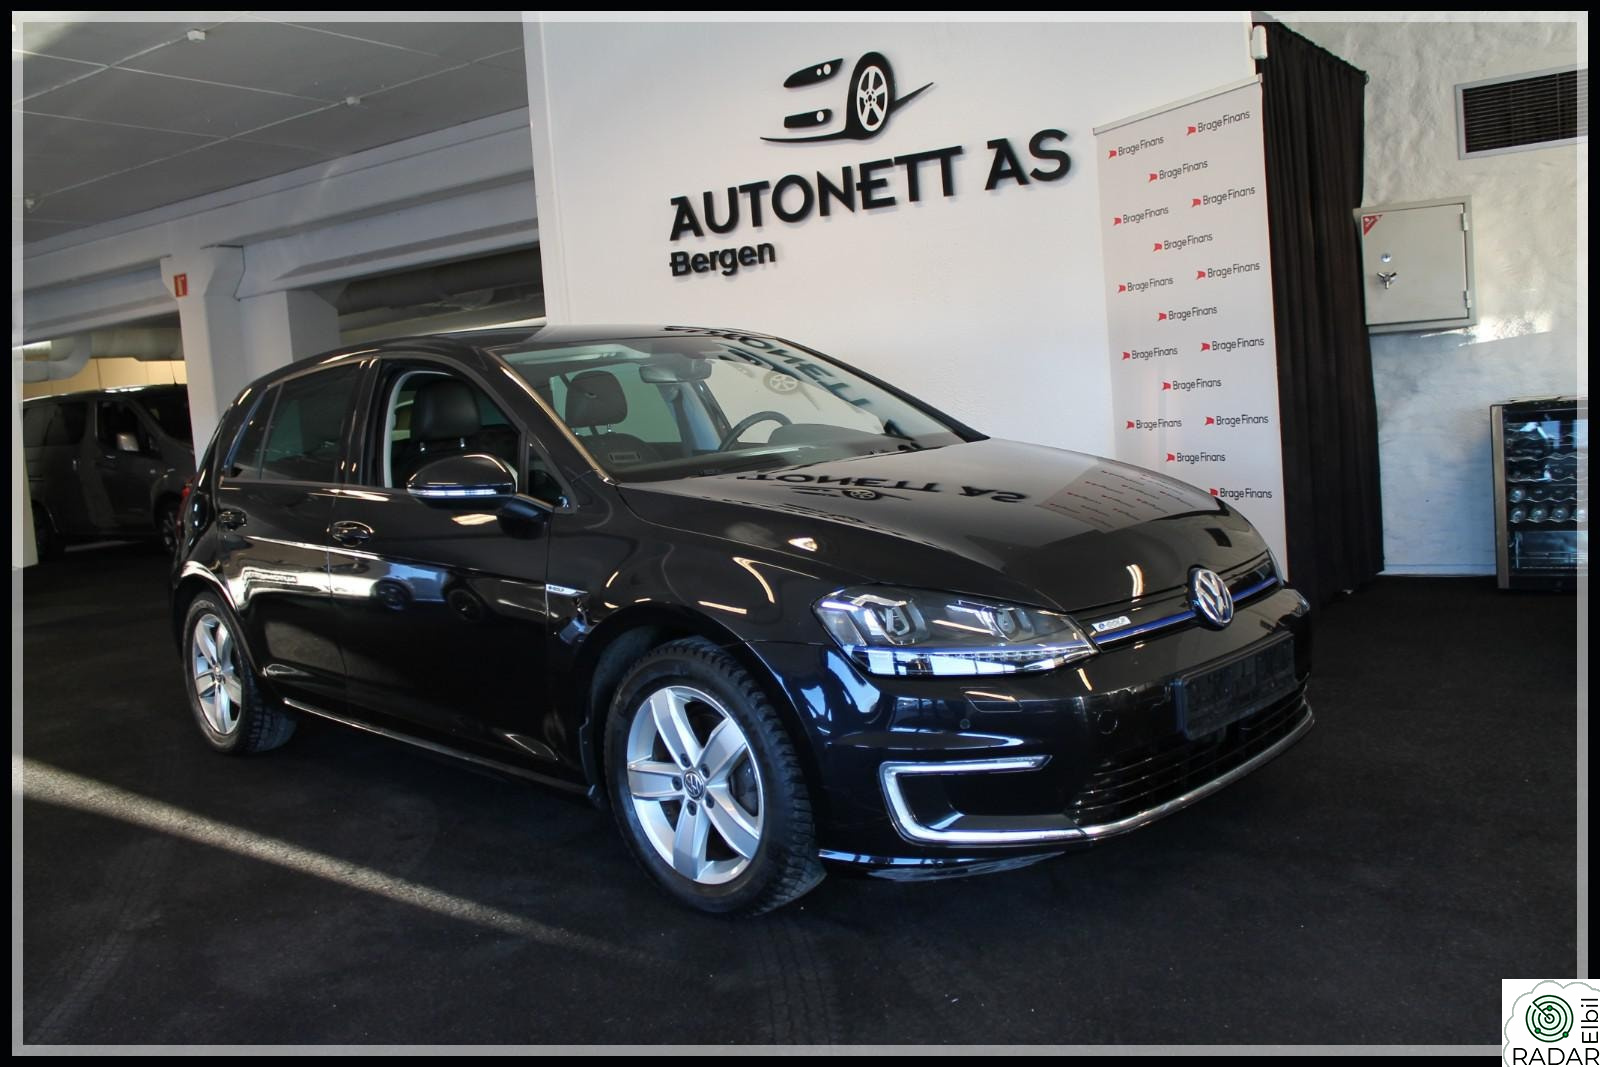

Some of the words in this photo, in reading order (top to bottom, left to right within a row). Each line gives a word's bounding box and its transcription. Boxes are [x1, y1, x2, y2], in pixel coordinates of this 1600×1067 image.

[1198, 120, 1223, 133] Brage
[1223, 112, 1250, 125] Finans
[1118, 144, 1140, 156] Brage
[1140, 137, 1164, 149] Finans
[1159, 168, 1182, 180] Brage
[1182, 161, 1208, 174] Finans
[669, 145, 963, 241] AUTONETT
[984, 128, 1072, 191] AS
[1203, 194, 1228, 205] Brage
[1228, 187, 1255, 200] Finans
[1123, 213, 1145, 224] Brage
[1145, 207, 1169, 218] Finans
[1164, 239, 1187, 250] Brage
[1187, 234, 1213, 245] Finans
[669, 242, 776, 276] Bergen
[1208, 268, 1232, 279] Brage
[1233, 263, 1260, 274] Finans
[1128, 280, 1150, 292] Brage
[1150, 278, 1174, 288] Finans
[1168, 310, 1192, 321] Brage
[1192, 307, 1218, 317] Finans
[1212, 341, 1237, 352] Brage
[1237, 338, 1265, 348] Finans
[1132, 350, 1153, 361] Brage
[1154, 347, 1178, 357] Finans
[1173, 380, 1196, 392] Brage
[1196, 378, 1222, 388] Finans
[1136, 420, 1158, 431] Brage
[1158, 418, 1182, 428] Finans
[1216, 416, 1241, 428] Brage
[1241, 414, 1269, 424] Finans
[1177, 452, 1200, 465] Brage
[1200, 452, 1226, 462] Finans
[1220, 488, 1245, 499] Brage
[1245, 488, 1273, 499] Finans
